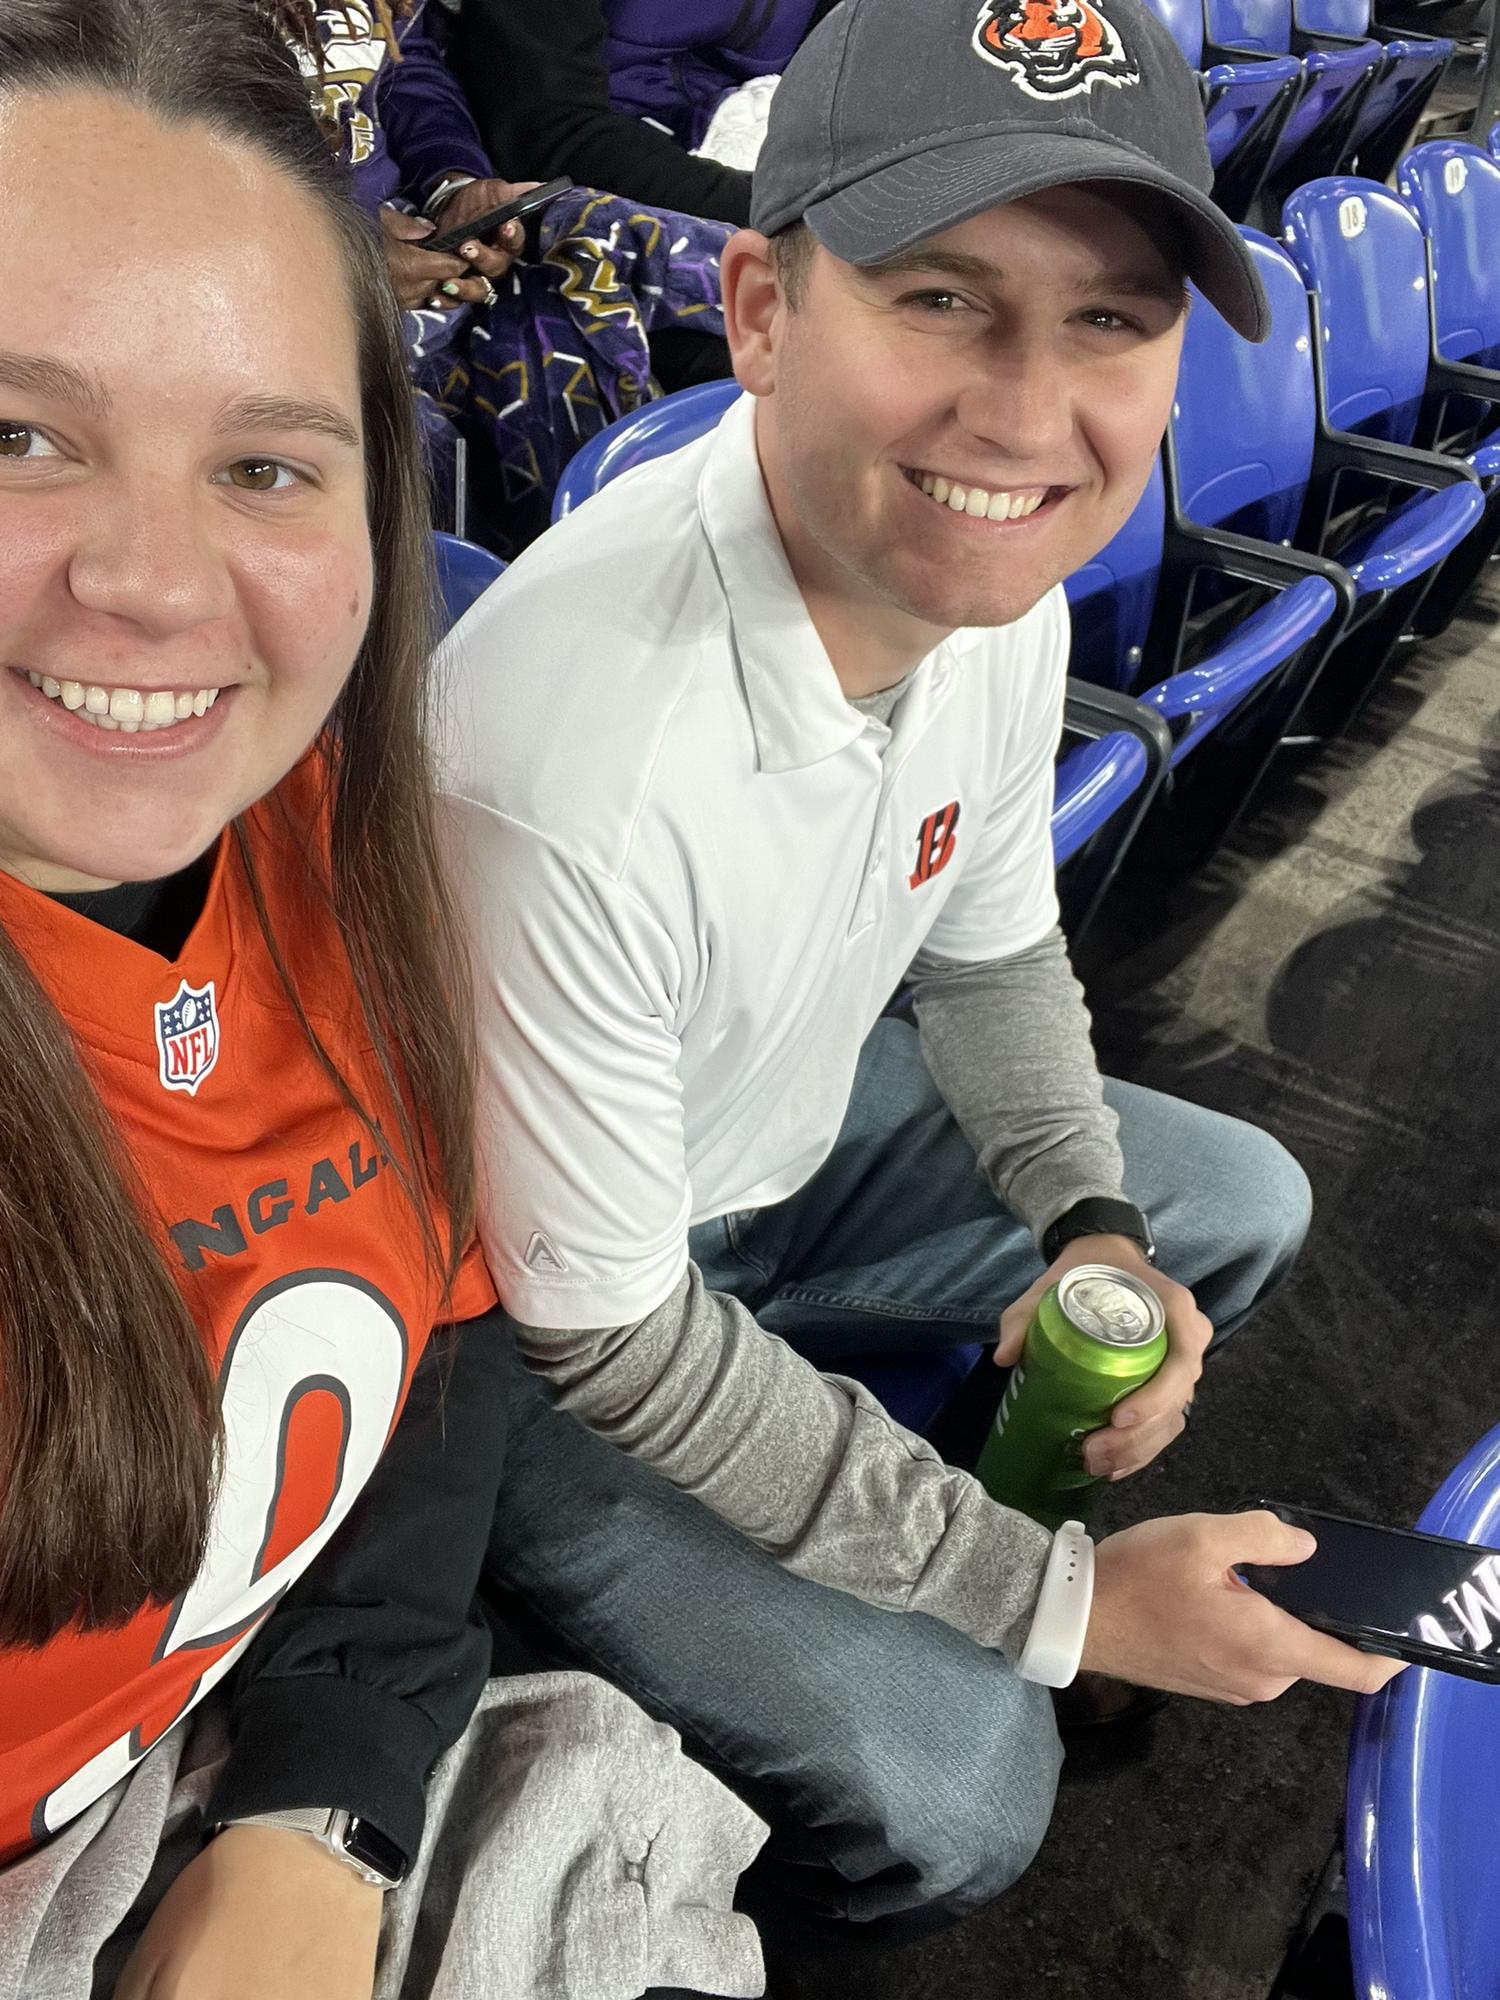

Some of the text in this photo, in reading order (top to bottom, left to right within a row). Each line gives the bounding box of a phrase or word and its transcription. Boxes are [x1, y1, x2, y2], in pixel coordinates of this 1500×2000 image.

[1345, 203, 1359, 230] 18
[907, 799, 961, 891] B
[169, 1026, 213, 1077] NFL
[168, 1118, 391, 1273] NGAL
